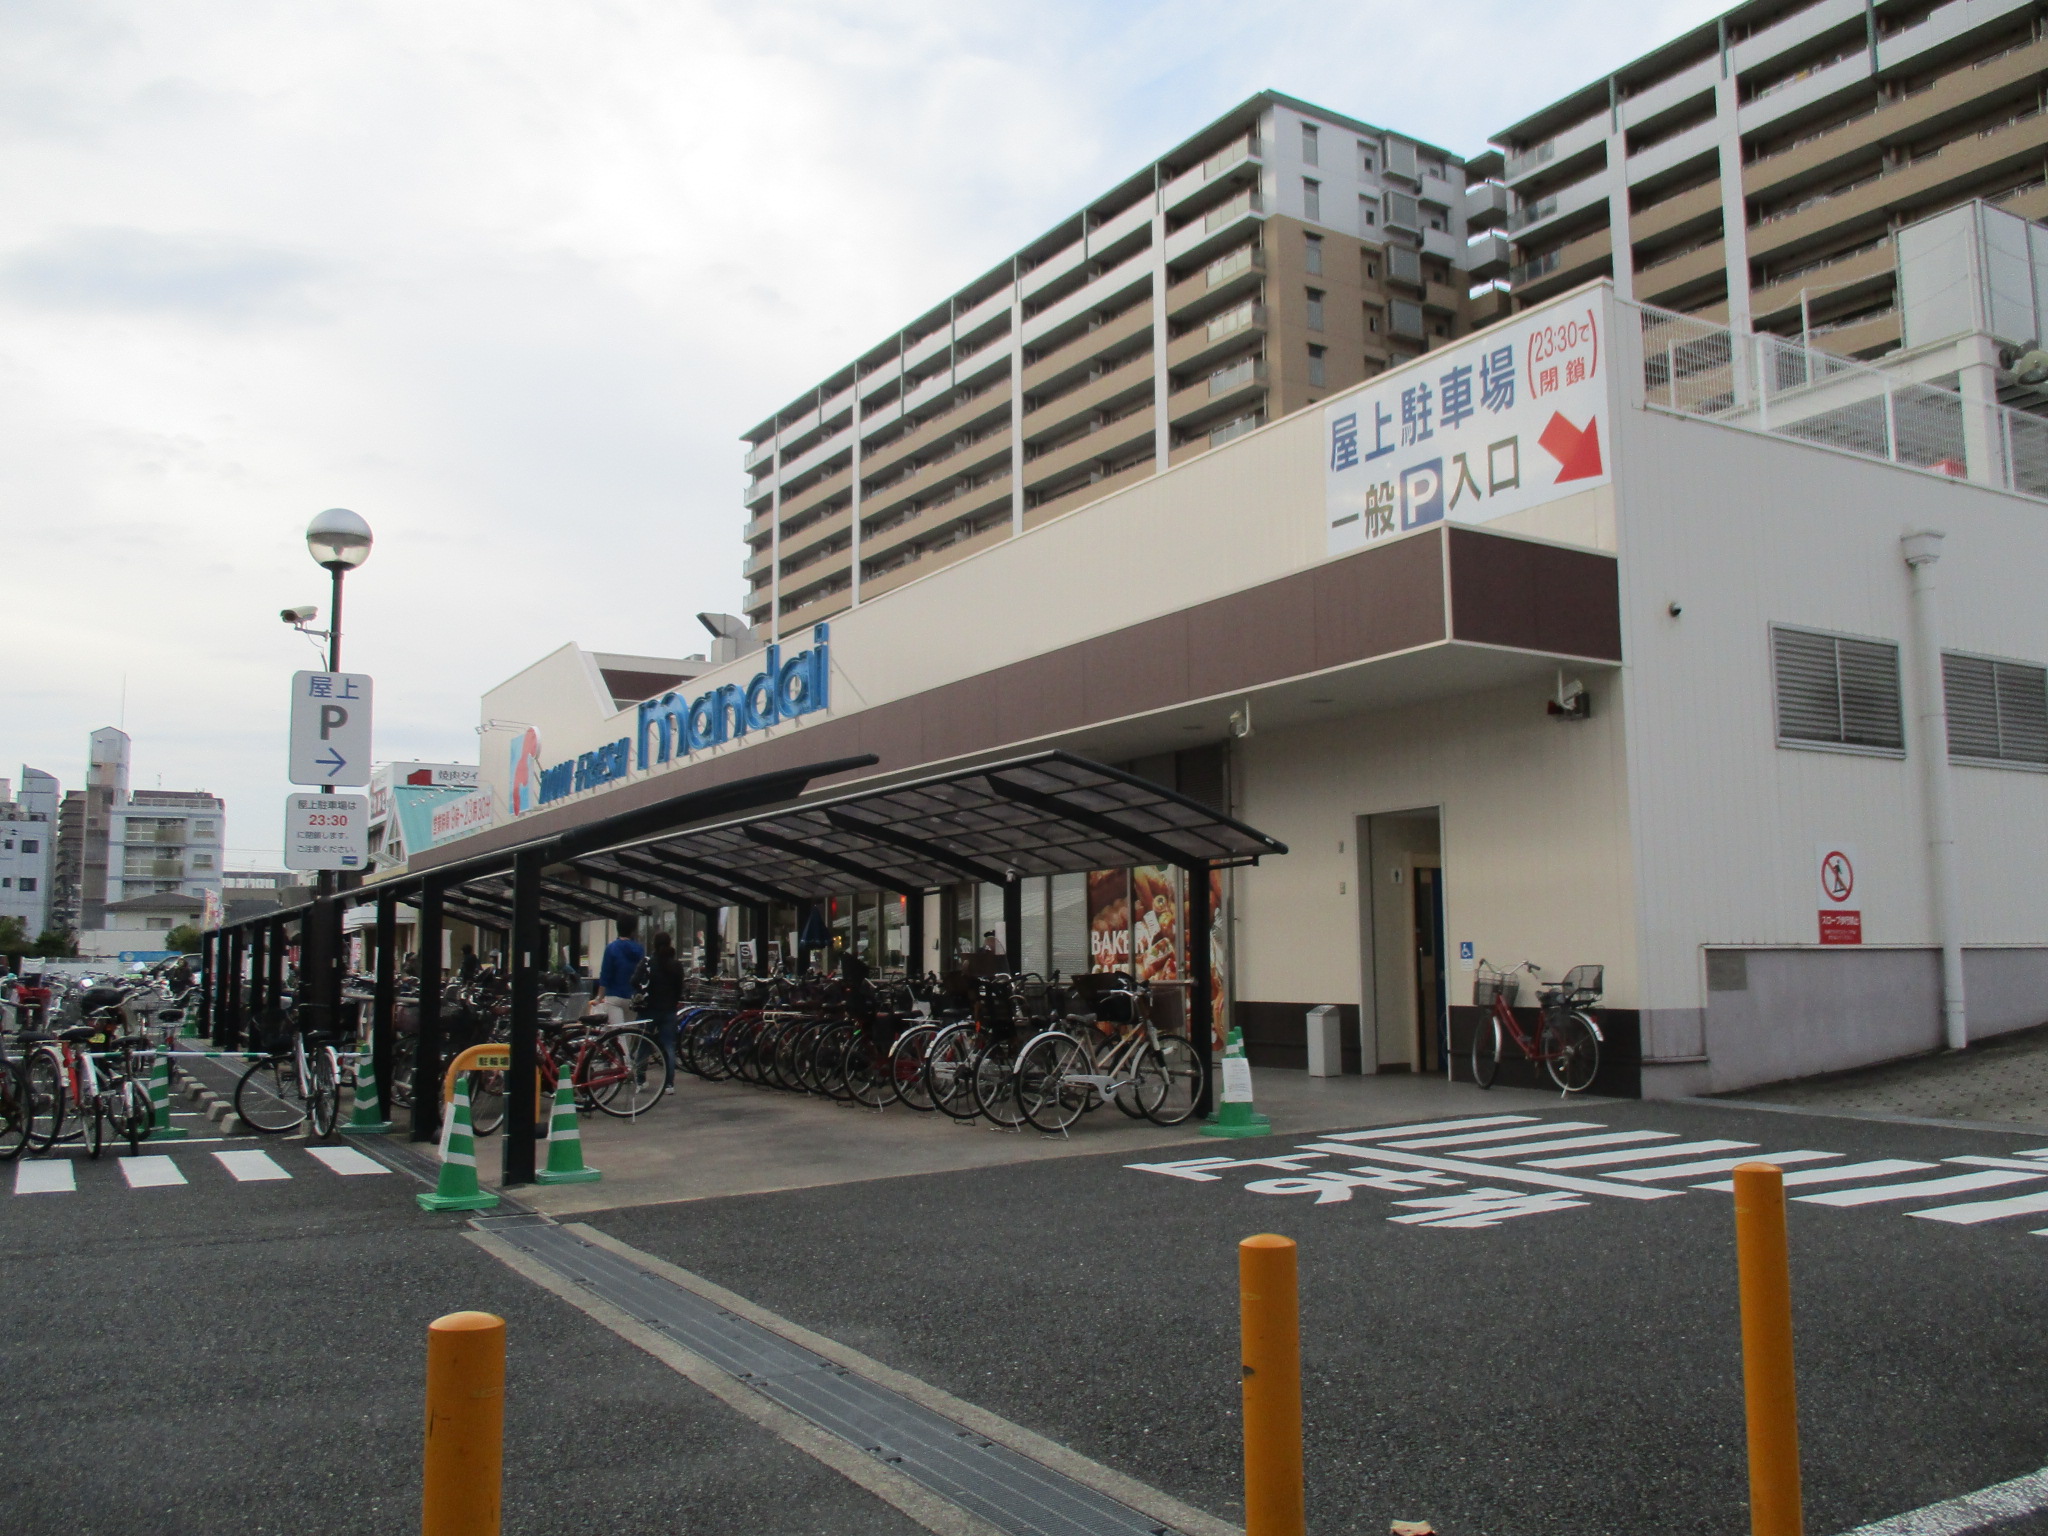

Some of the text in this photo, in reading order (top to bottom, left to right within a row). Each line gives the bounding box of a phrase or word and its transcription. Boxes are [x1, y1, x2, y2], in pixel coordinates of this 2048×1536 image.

[1330, 344, 1515, 473] 屋上駐車場
[309, 675, 359, 699] 屋上
[637, 622, 829, 770] mandai
[320, 704, 348, 740] P
[298, 800, 356, 810] 屋上駐車場は
[309, 814, 348, 826] 23:30
[1122, 1151, 1590, 1229] 止まれ
